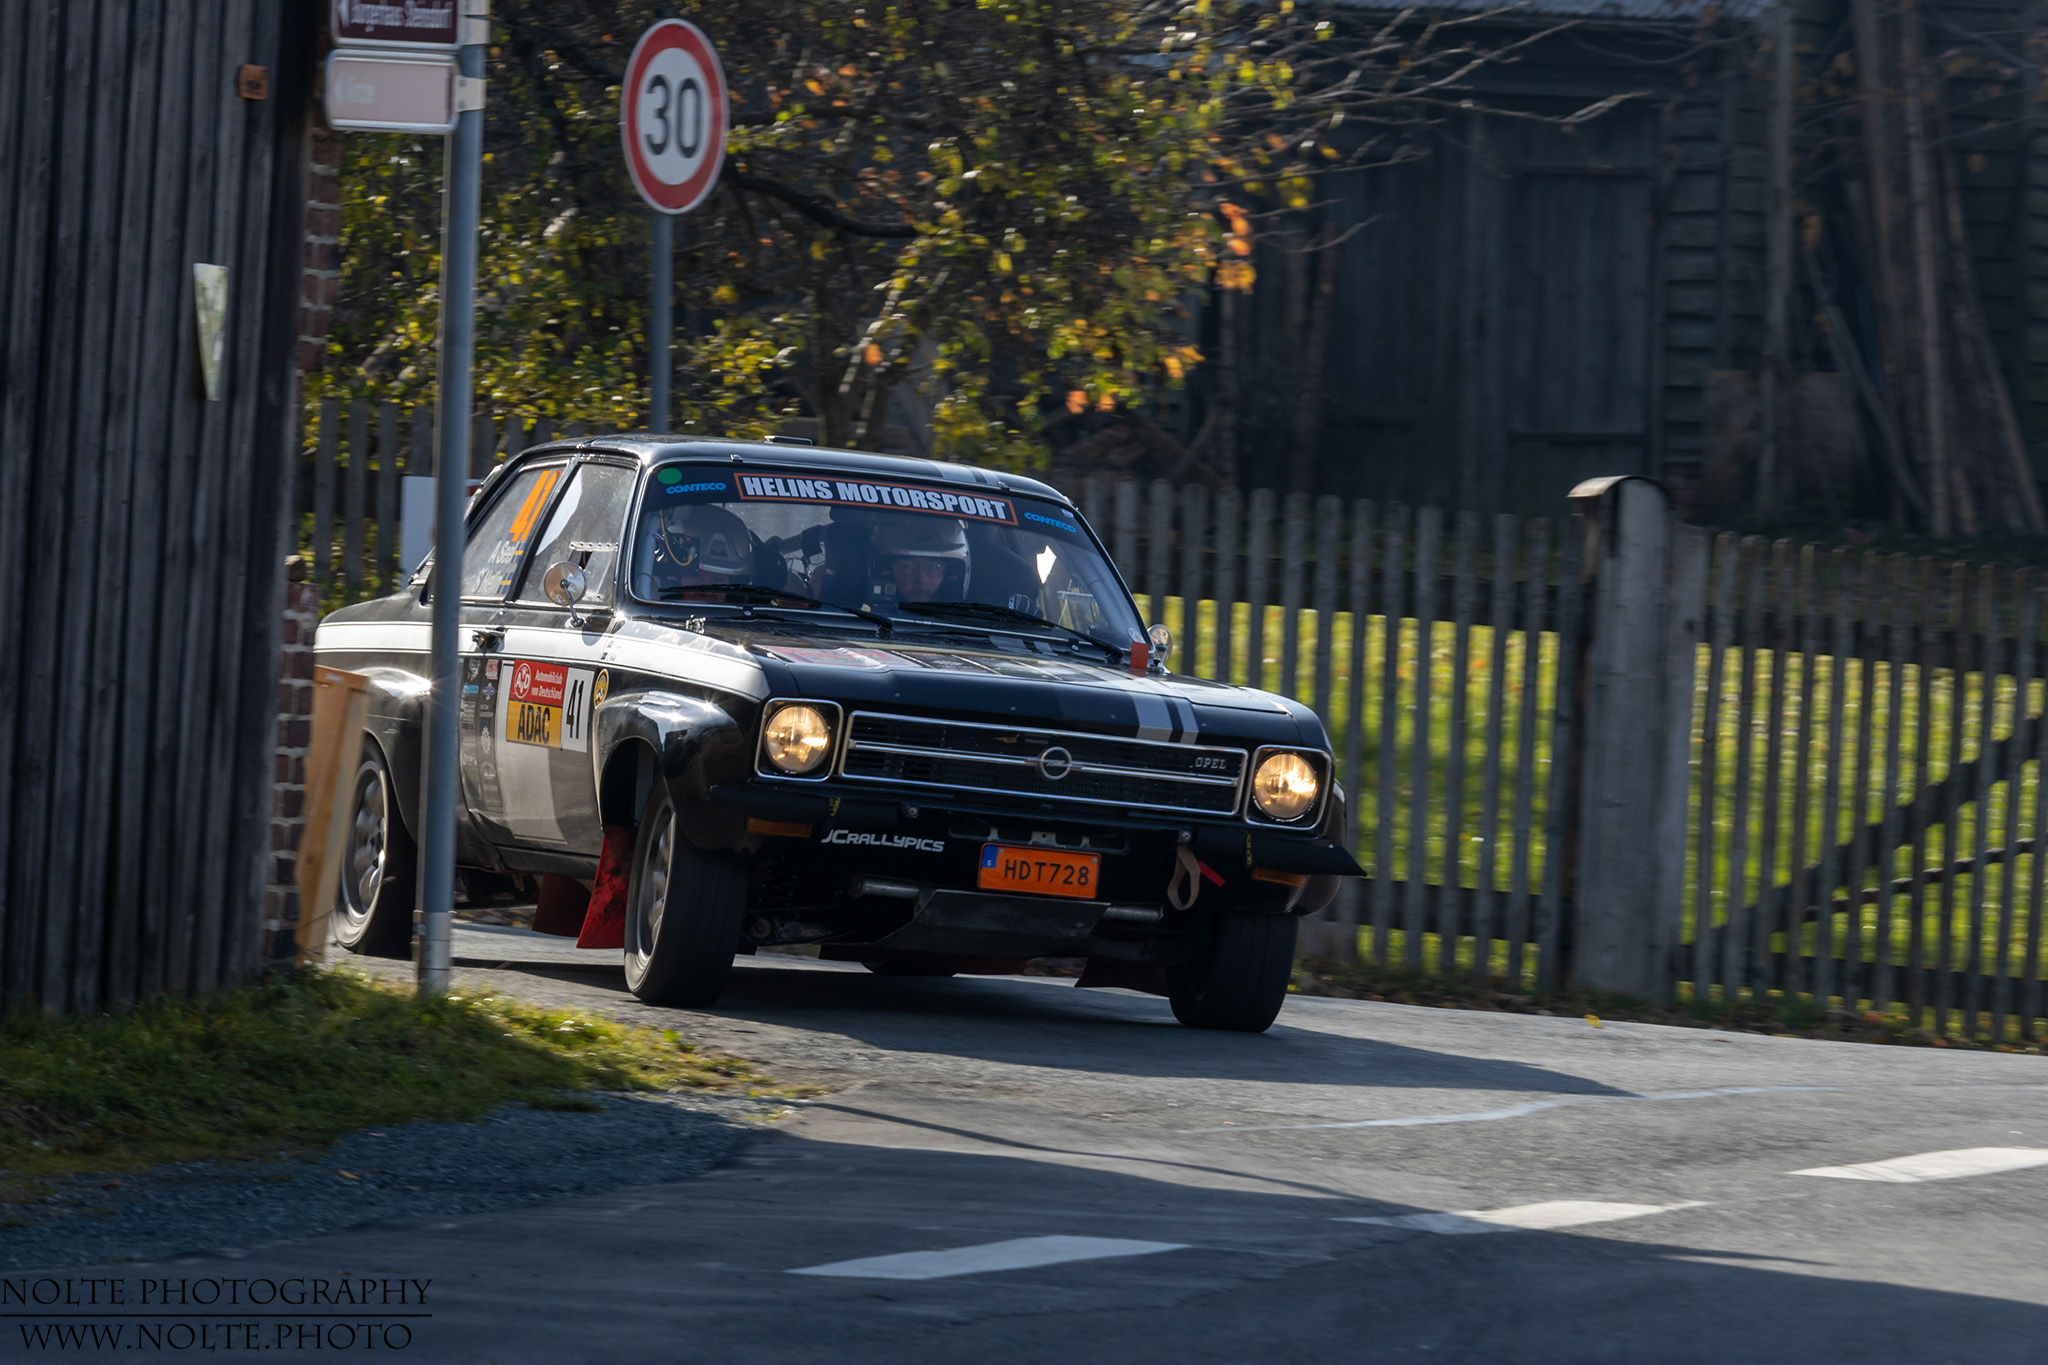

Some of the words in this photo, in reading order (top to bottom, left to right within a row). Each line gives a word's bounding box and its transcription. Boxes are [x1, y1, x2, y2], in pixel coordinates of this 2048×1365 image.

[645, 74, 703, 159] 30
[665, 482, 727, 495] CONTECO
[742, 477, 833, 500] HELINS
[839, 482, 1006, 520] MOTORSPORT
[1023, 511, 1077, 534] CONTECO
[531, 686, 539, 696] von
[538, 685, 563, 700] Deutschland
[566, 679, 584, 740] 41
[517, 704, 550, 744] ADAC
[1195, 757, 1227, 769] OPEL
[1003, 858, 1090, 886] HDT728
